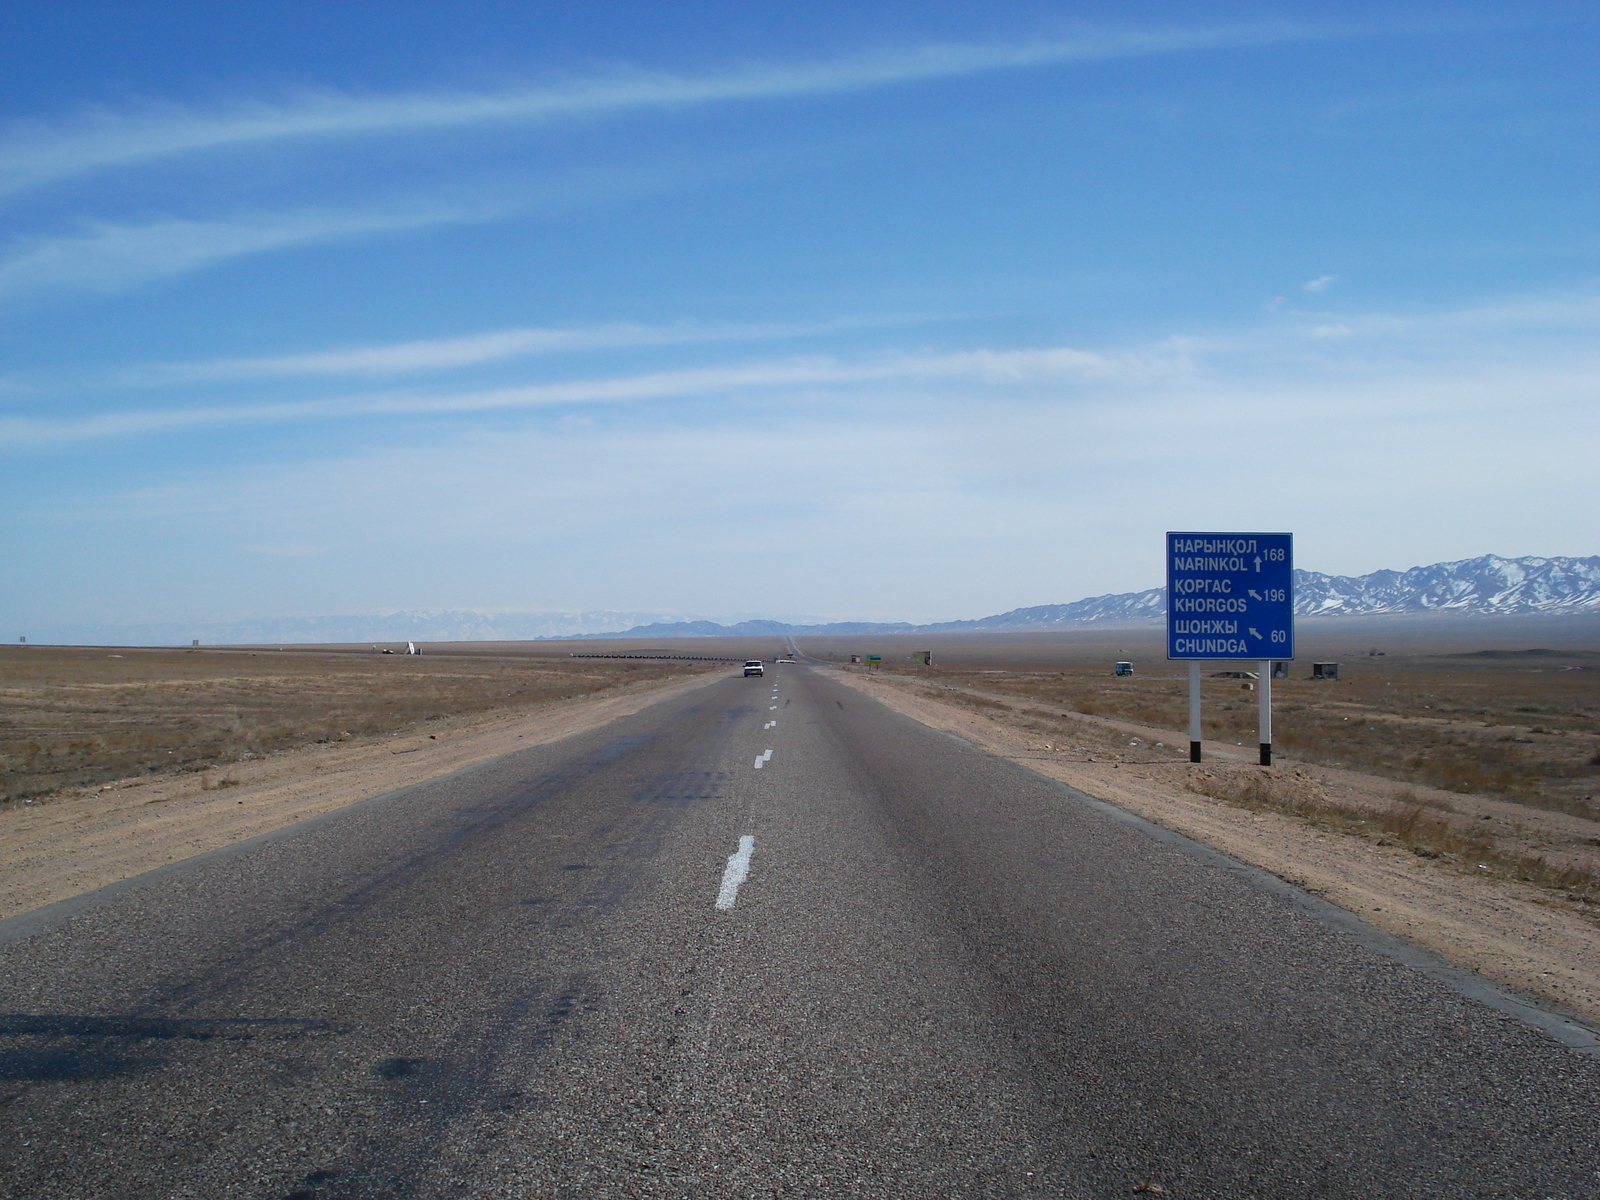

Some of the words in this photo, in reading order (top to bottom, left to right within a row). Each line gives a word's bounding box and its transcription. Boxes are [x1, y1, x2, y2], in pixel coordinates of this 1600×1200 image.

[1174, 539, 1257, 556] НАРЫНҚОЛ
[1263, 548, 1285, 561] 168
[1174, 557, 1248, 571] NARINKOL
[1263, 589, 1285, 602] 196
[1175, 598, 1247, 612] KHORGOS
[1175, 619, 1238, 634] ШОНЖЫ
[1270, 630, 1286, 643] 60
[1175, 639, 1248, 653] CHUNDGA
